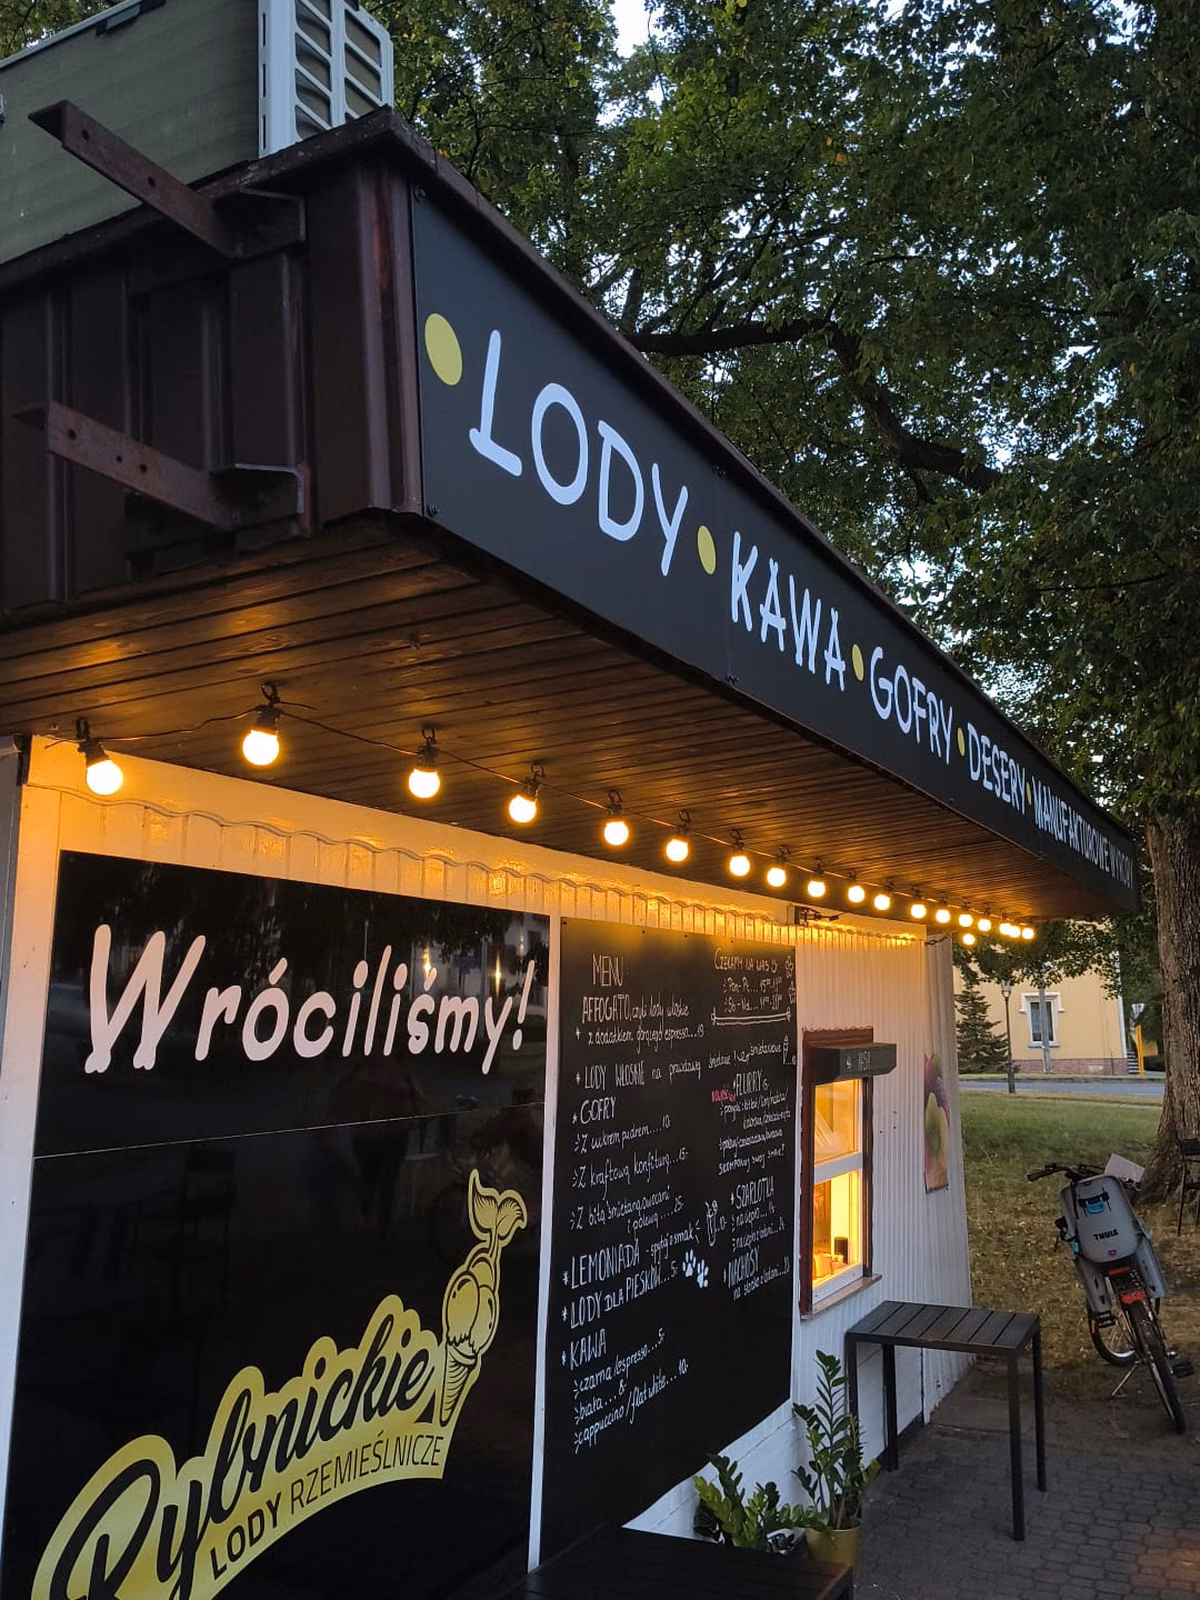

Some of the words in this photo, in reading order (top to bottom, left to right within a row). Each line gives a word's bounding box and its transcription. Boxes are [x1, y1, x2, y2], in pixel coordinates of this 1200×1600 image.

[469, 329, 689, 576] LODY
[732, 531, 846, 692] KAWA
[870, 646, 953, 765] GOFRY
[967, 722, 1026, 815] DESERY
[592, 953, 624, 987] MENU
[84, 924, 535, 1074] Wróciliśmy!
[584, 1064, 607, 1092] LODY
[580, 1096, 617, 1125] GOFRY
[590, 1157, 631, 1201] kraftową
[1093, 1228, 1119, 1241] THULE
[571, 1239, 641, 1290] LEMONIADA
[570, 1290, 603, 1329] LODY
[604, 1288, 625, 1312] DLA
[570, 1328, 607, 1371] KAWA
[579, 1366, 613, 1393] czarna
[209, 1491, 283, 1581] LODY
[289, 1430, 445, 1515] RZEMIEŚLNICZE
